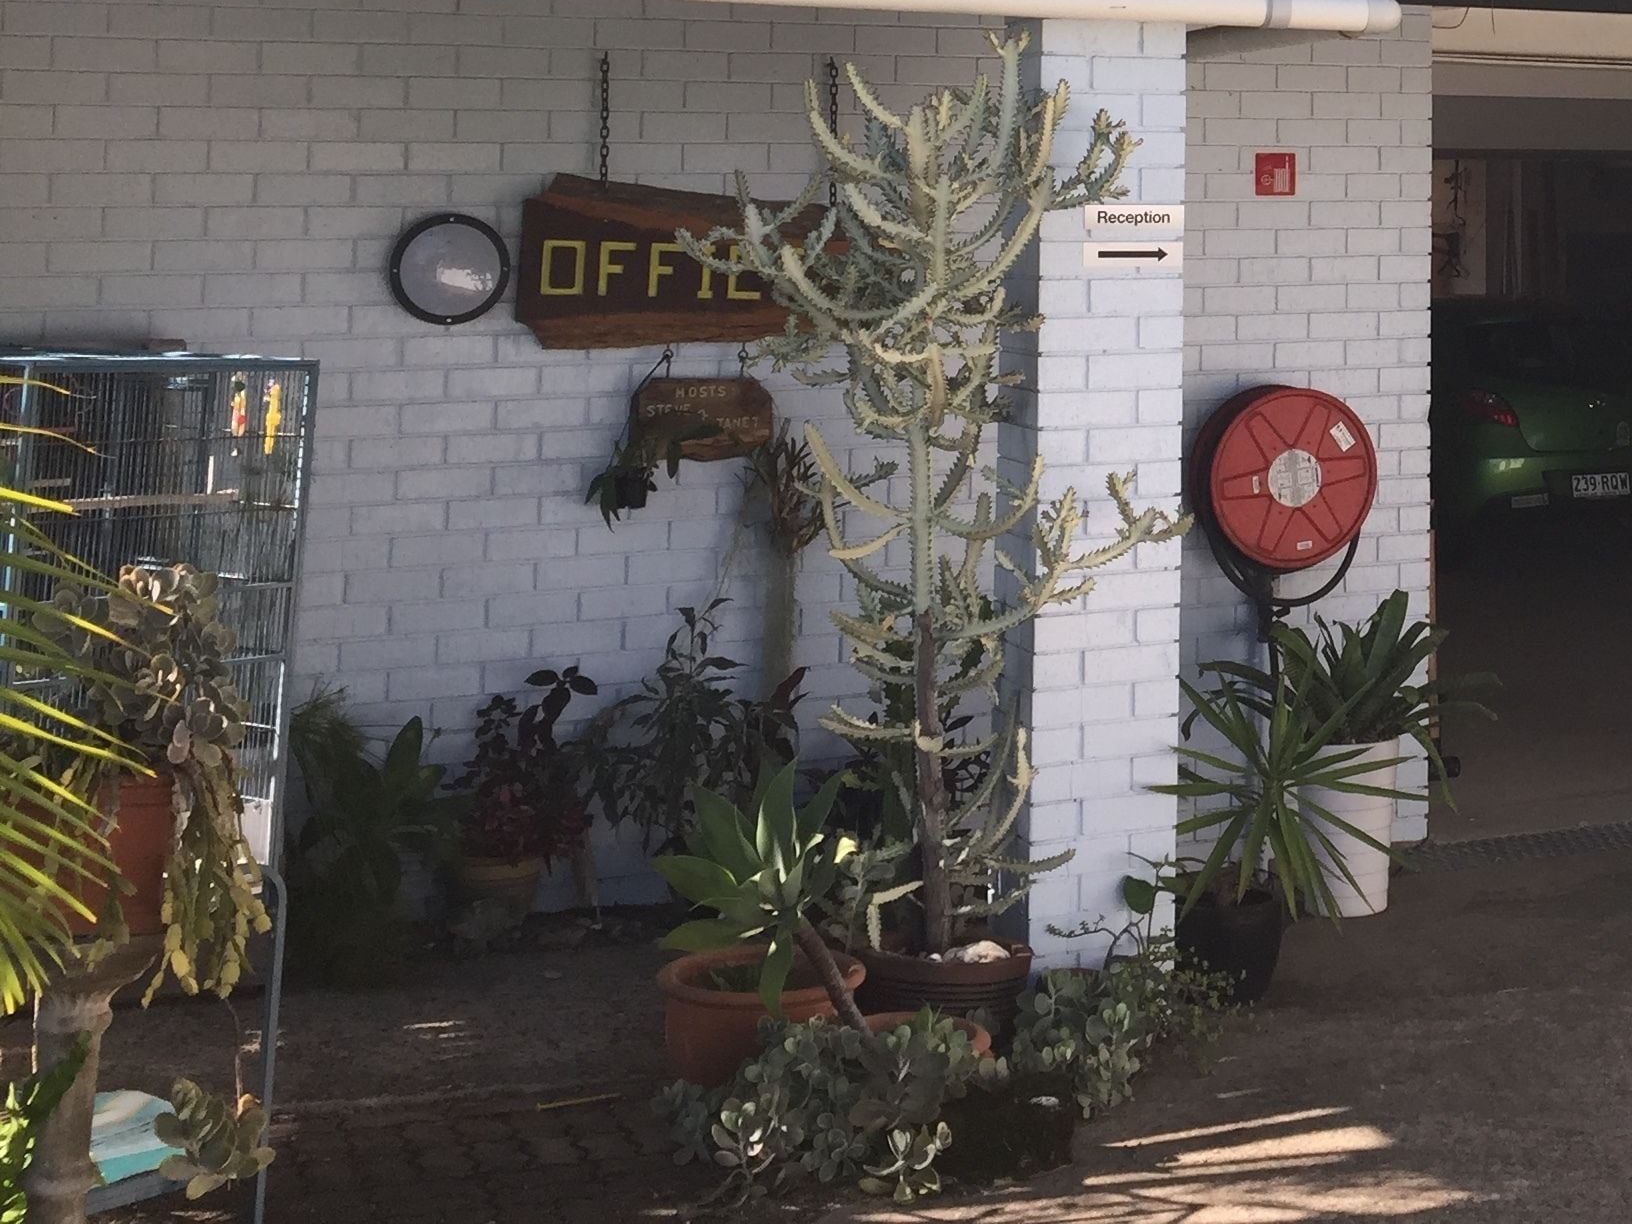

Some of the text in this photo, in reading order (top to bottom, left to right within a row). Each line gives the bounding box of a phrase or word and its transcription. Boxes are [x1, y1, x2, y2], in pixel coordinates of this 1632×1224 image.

[1097, 210, 1171, 226] Reception
[540, 239, 804, 300] OFFIC
[675, 385, 728, 398] HOSTS
